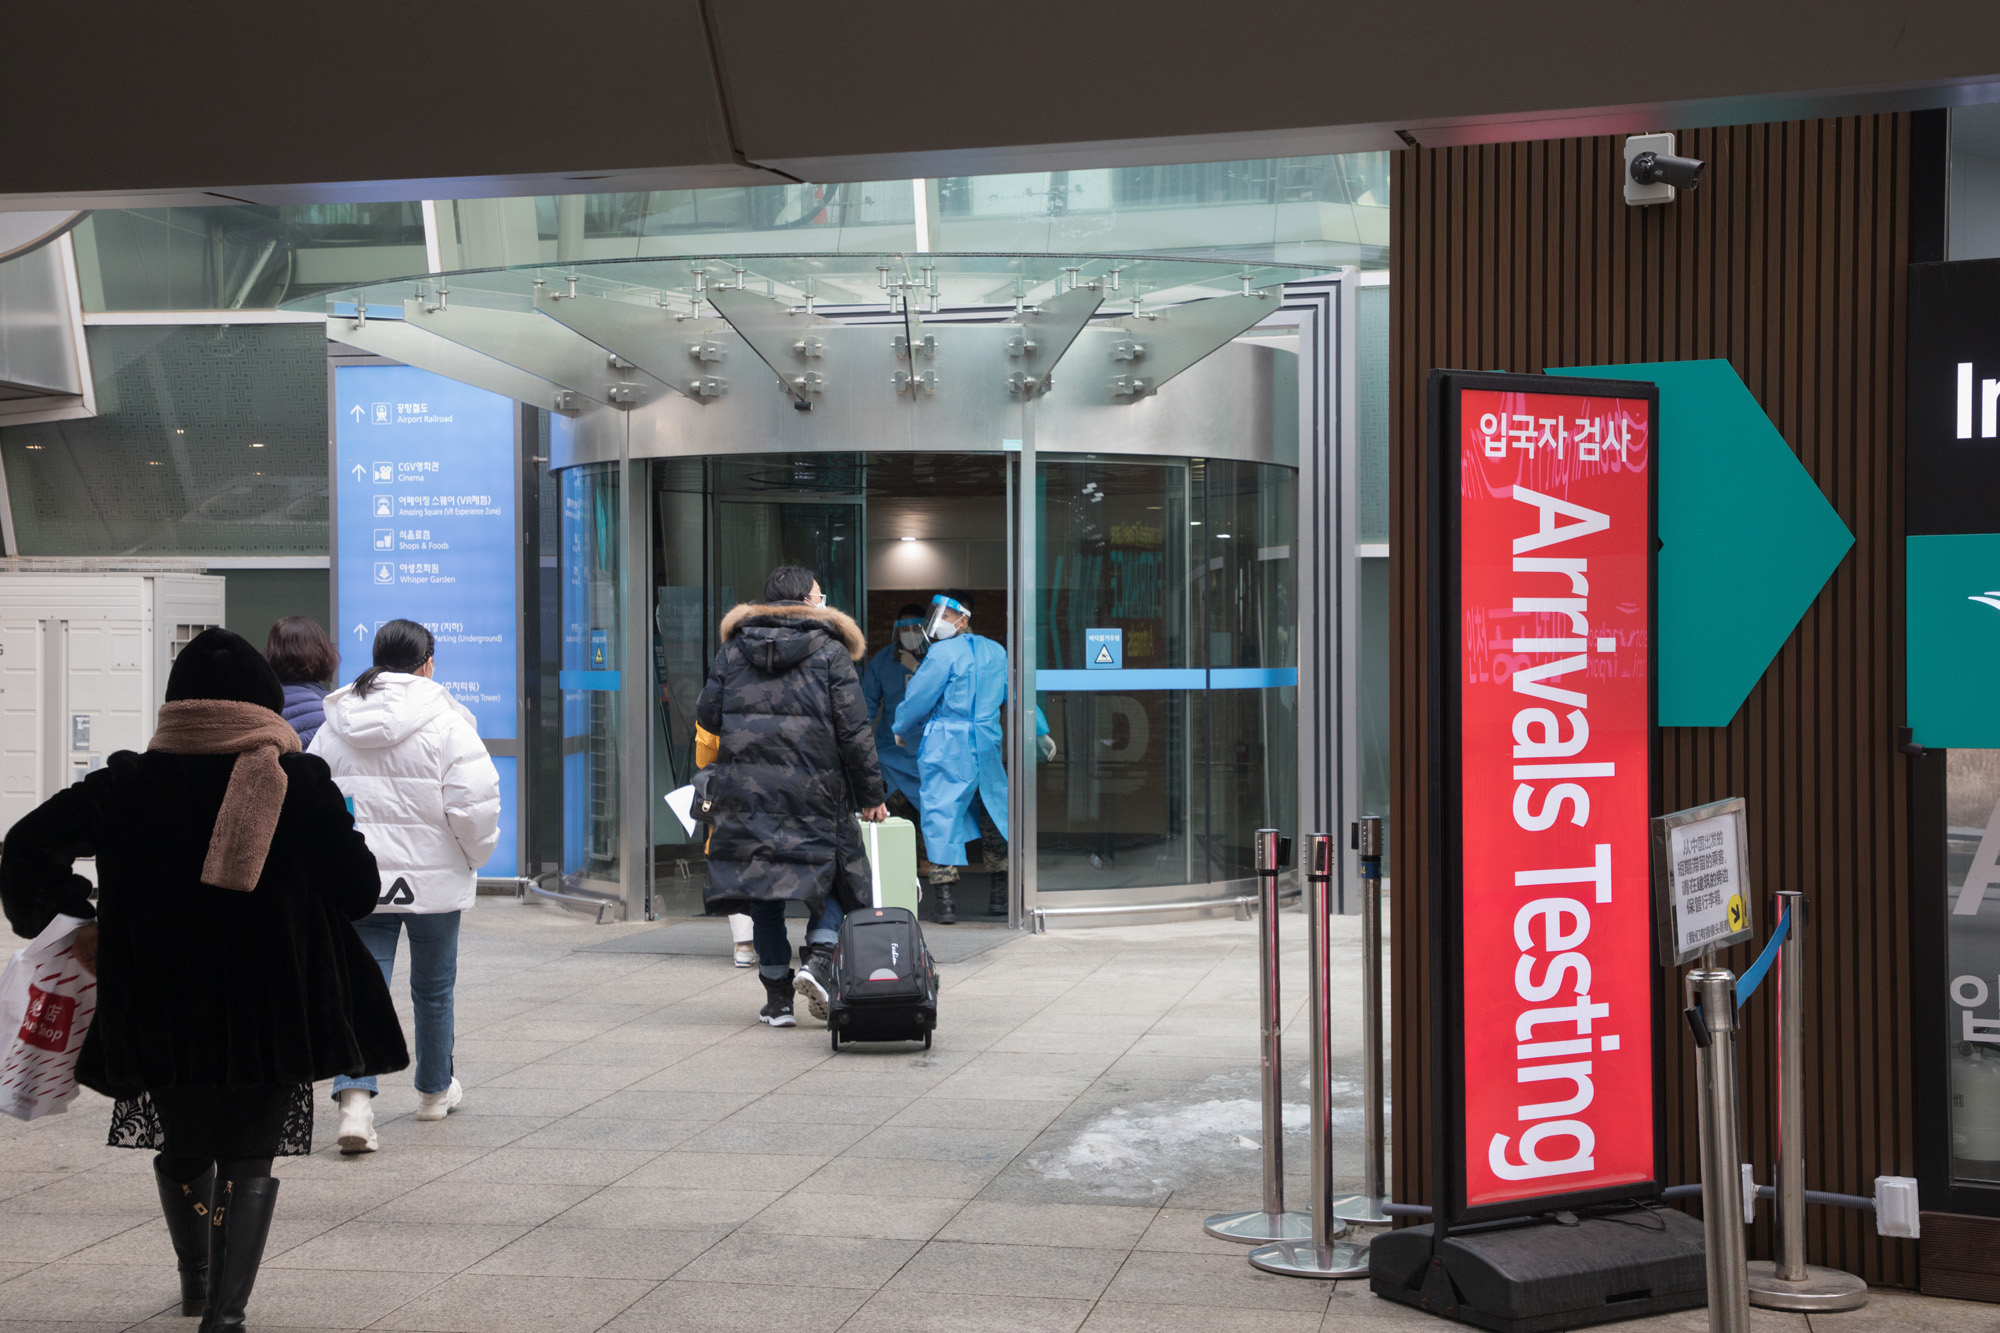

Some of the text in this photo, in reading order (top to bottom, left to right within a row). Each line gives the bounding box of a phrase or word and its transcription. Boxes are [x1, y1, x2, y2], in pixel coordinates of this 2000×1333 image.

[397, 403, 428, 414] 공항철도
[397, 414, 453, 424] Airport Railroad
[1480, 412, 1568, 460] 입국자
[1574, 416, 1631, 463] 검사
[398, 461, 439, 472] CGV영화관
[398, 474, 424, 482] Cinema
[399, 507, 501, 517] Amazing Square (VR Experience Zone)
[399, 541, 420, 551] Shops
[428, 541, 449, 550] Foods
[399, 575, 456, 585] Whisper Garden
[440, 622, 464, 633] (지하)
[458, 634, 503, 644] (Underground)
[1511, 484, 1616, 832] Arrivals
[455, 694, 501, 703] (Parking Tower)
[1683, 830, 1723, 855] 从中国出发的
[1488, 843, 1620, 1181] Testing
